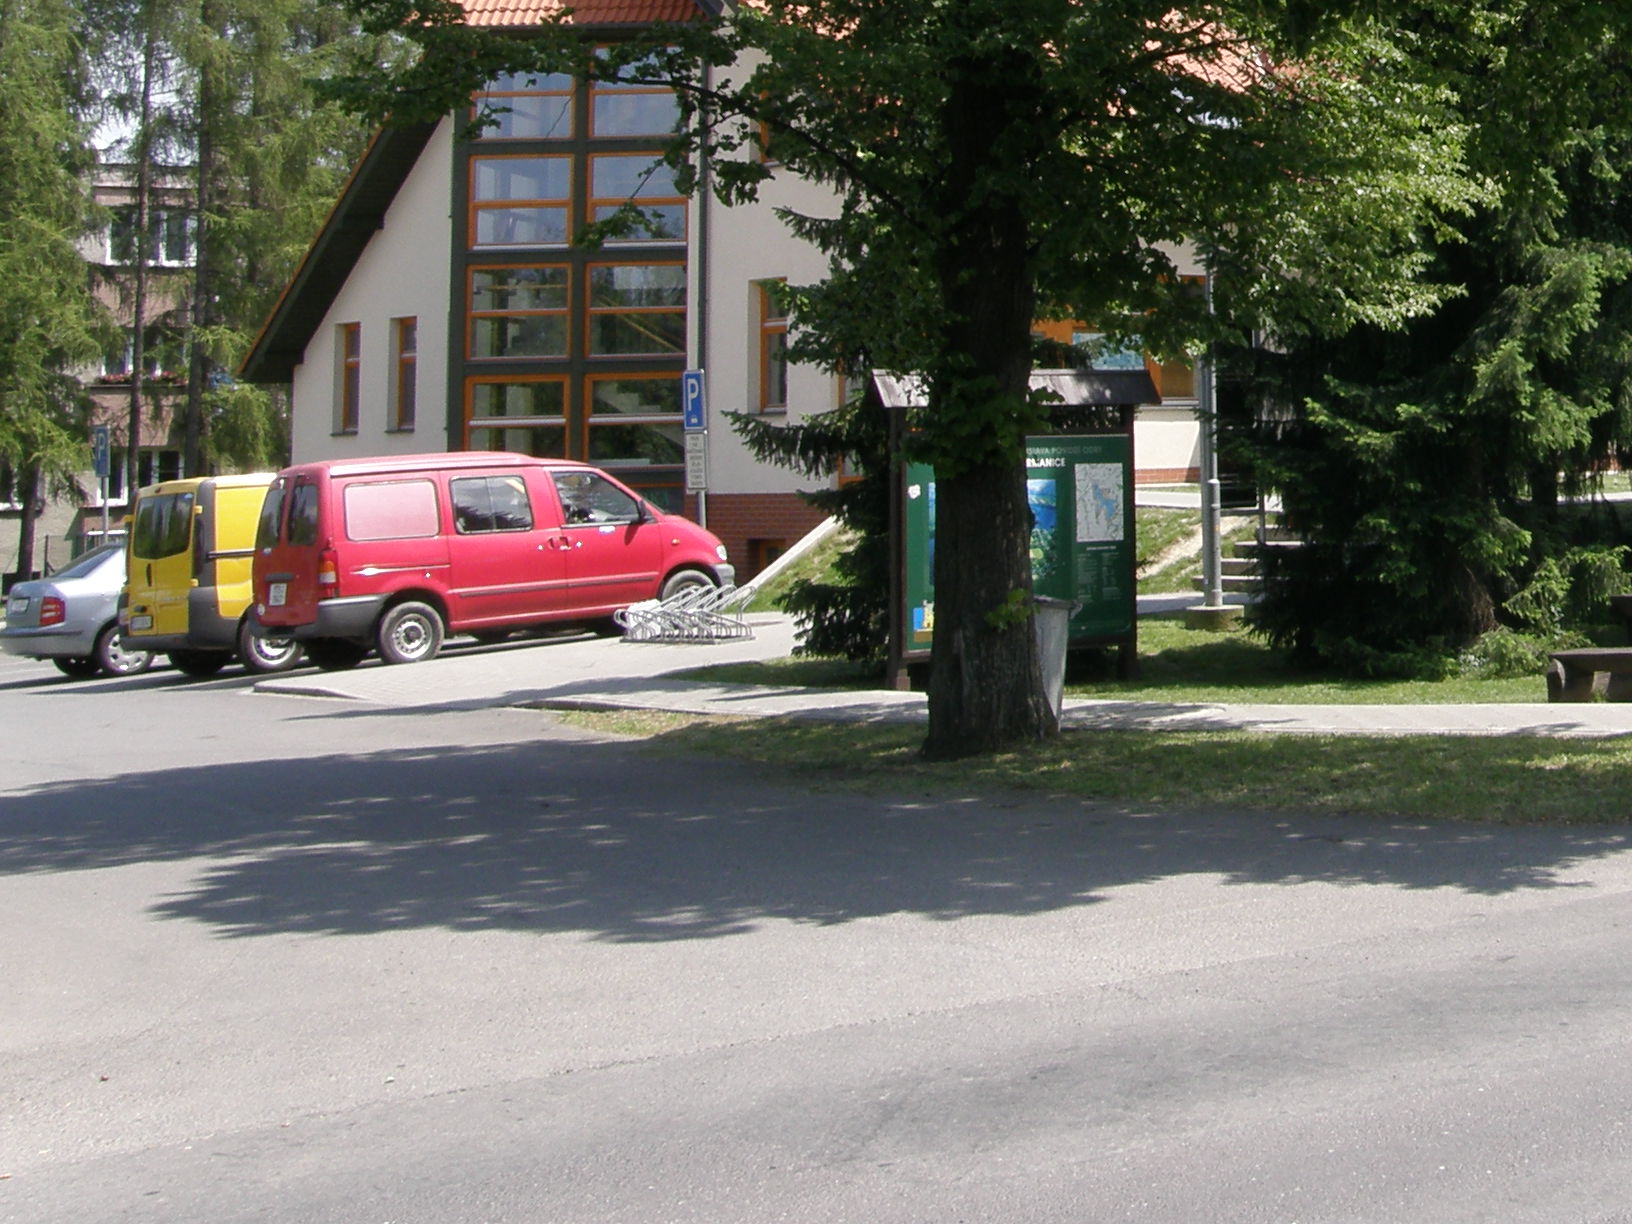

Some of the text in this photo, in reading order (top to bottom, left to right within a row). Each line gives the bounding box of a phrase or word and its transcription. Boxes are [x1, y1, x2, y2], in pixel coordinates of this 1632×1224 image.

[687, 378, 699, 411] P
[98, 433, 106, 460] P
[1026, 457, 1066, 468] RMANICE
